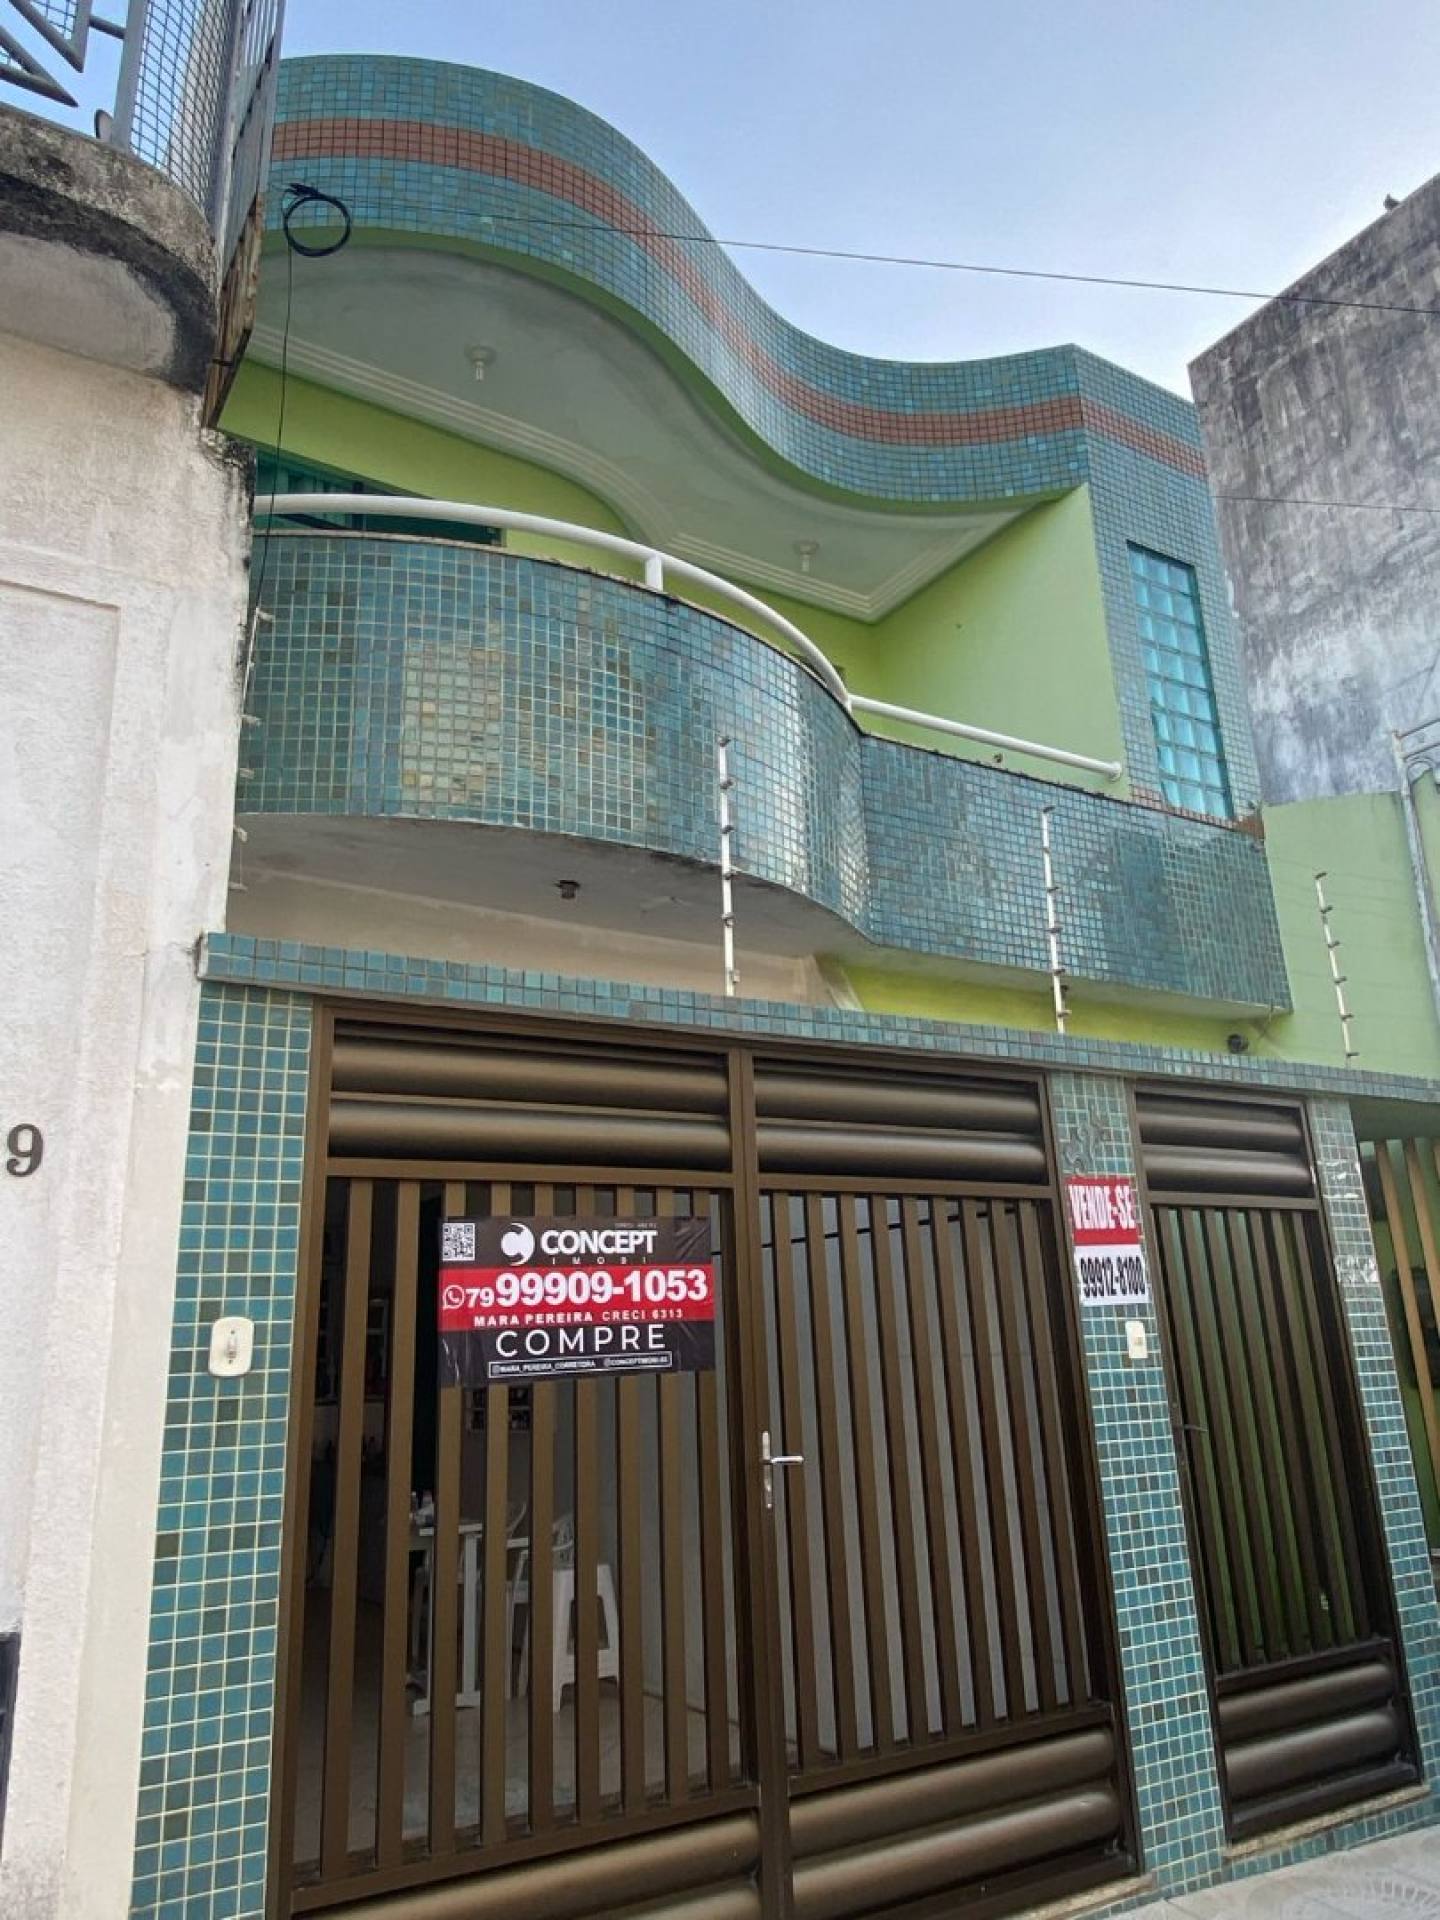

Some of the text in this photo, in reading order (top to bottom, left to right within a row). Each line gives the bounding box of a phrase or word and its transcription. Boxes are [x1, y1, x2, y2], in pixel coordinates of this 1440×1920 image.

[6, 1123, 44, 1177] 9
[1068, 1185, 1136, 1230] VENDE-SE
[541, 1229, 658, 1254] CONCEPT
[465, 1268, 708, 1308] 79 99909-1053
[474, 1313, 520, 1327] MARA
[525, 1310, 593, 1325] PEREIRA
[602, 1309, 646, 1321] CRECI
[495, 1323, 666, 1357] COMPRE
